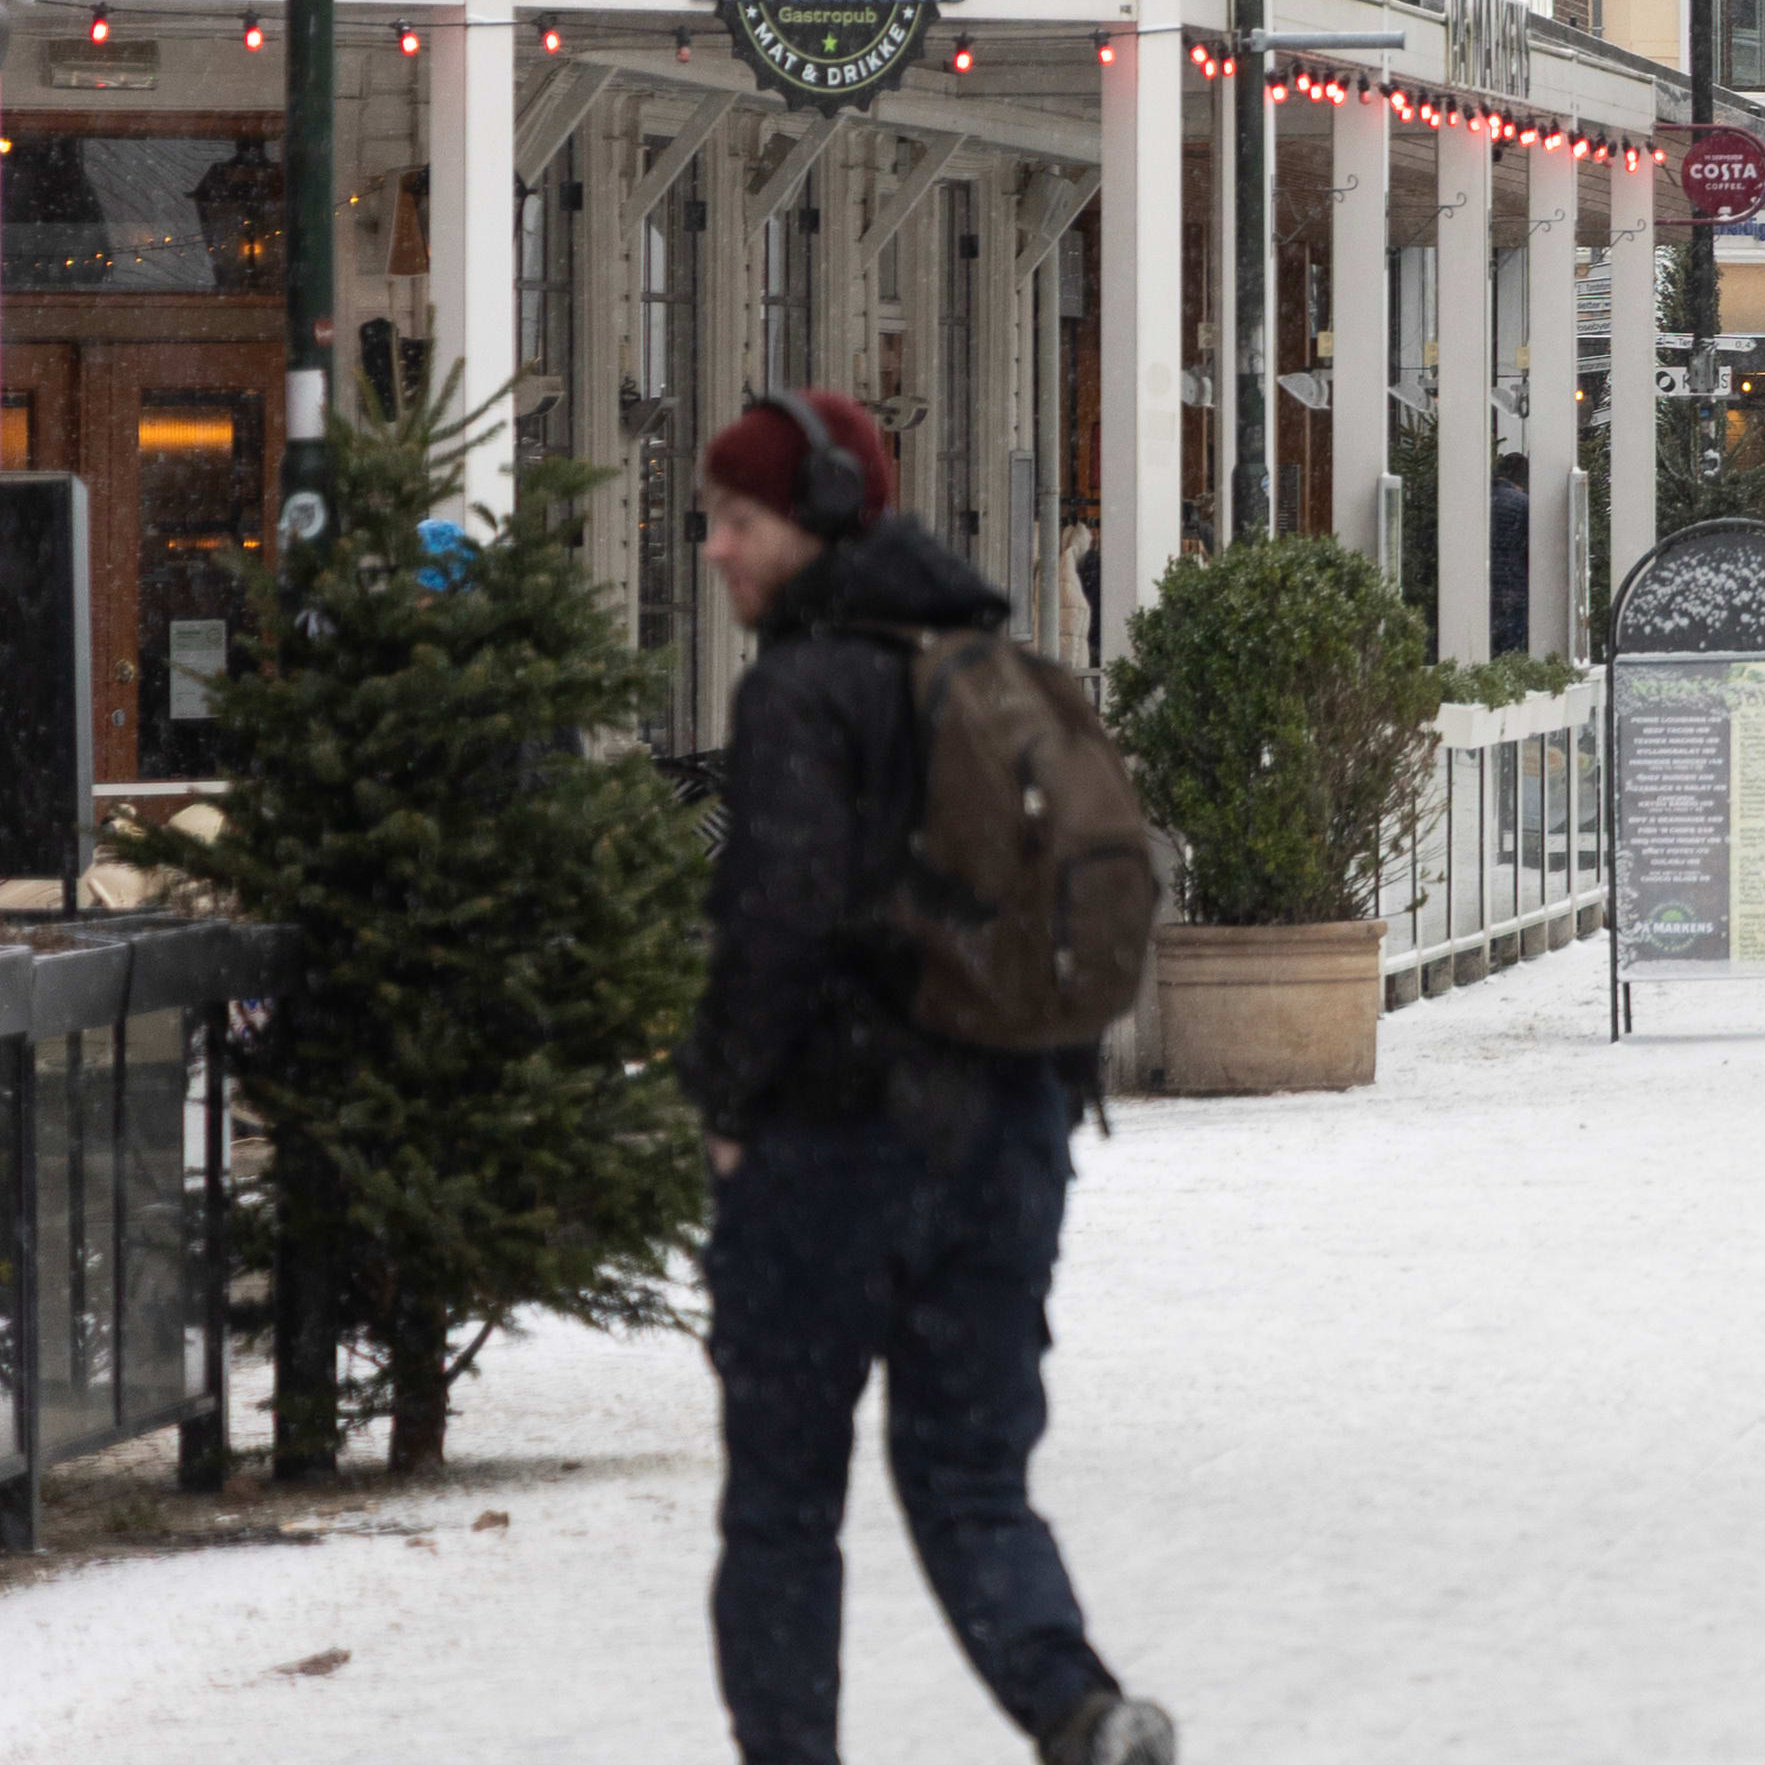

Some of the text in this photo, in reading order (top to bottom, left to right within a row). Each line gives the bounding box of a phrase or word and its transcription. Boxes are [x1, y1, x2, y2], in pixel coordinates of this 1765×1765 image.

[777, 6, 878, 27] Gastropub
[754, 22, 906, 87] MAT & DRIKKE
[1689, 163, 1759, 181] COSTA
[1652, 922, 1714, 935] MARKENS
